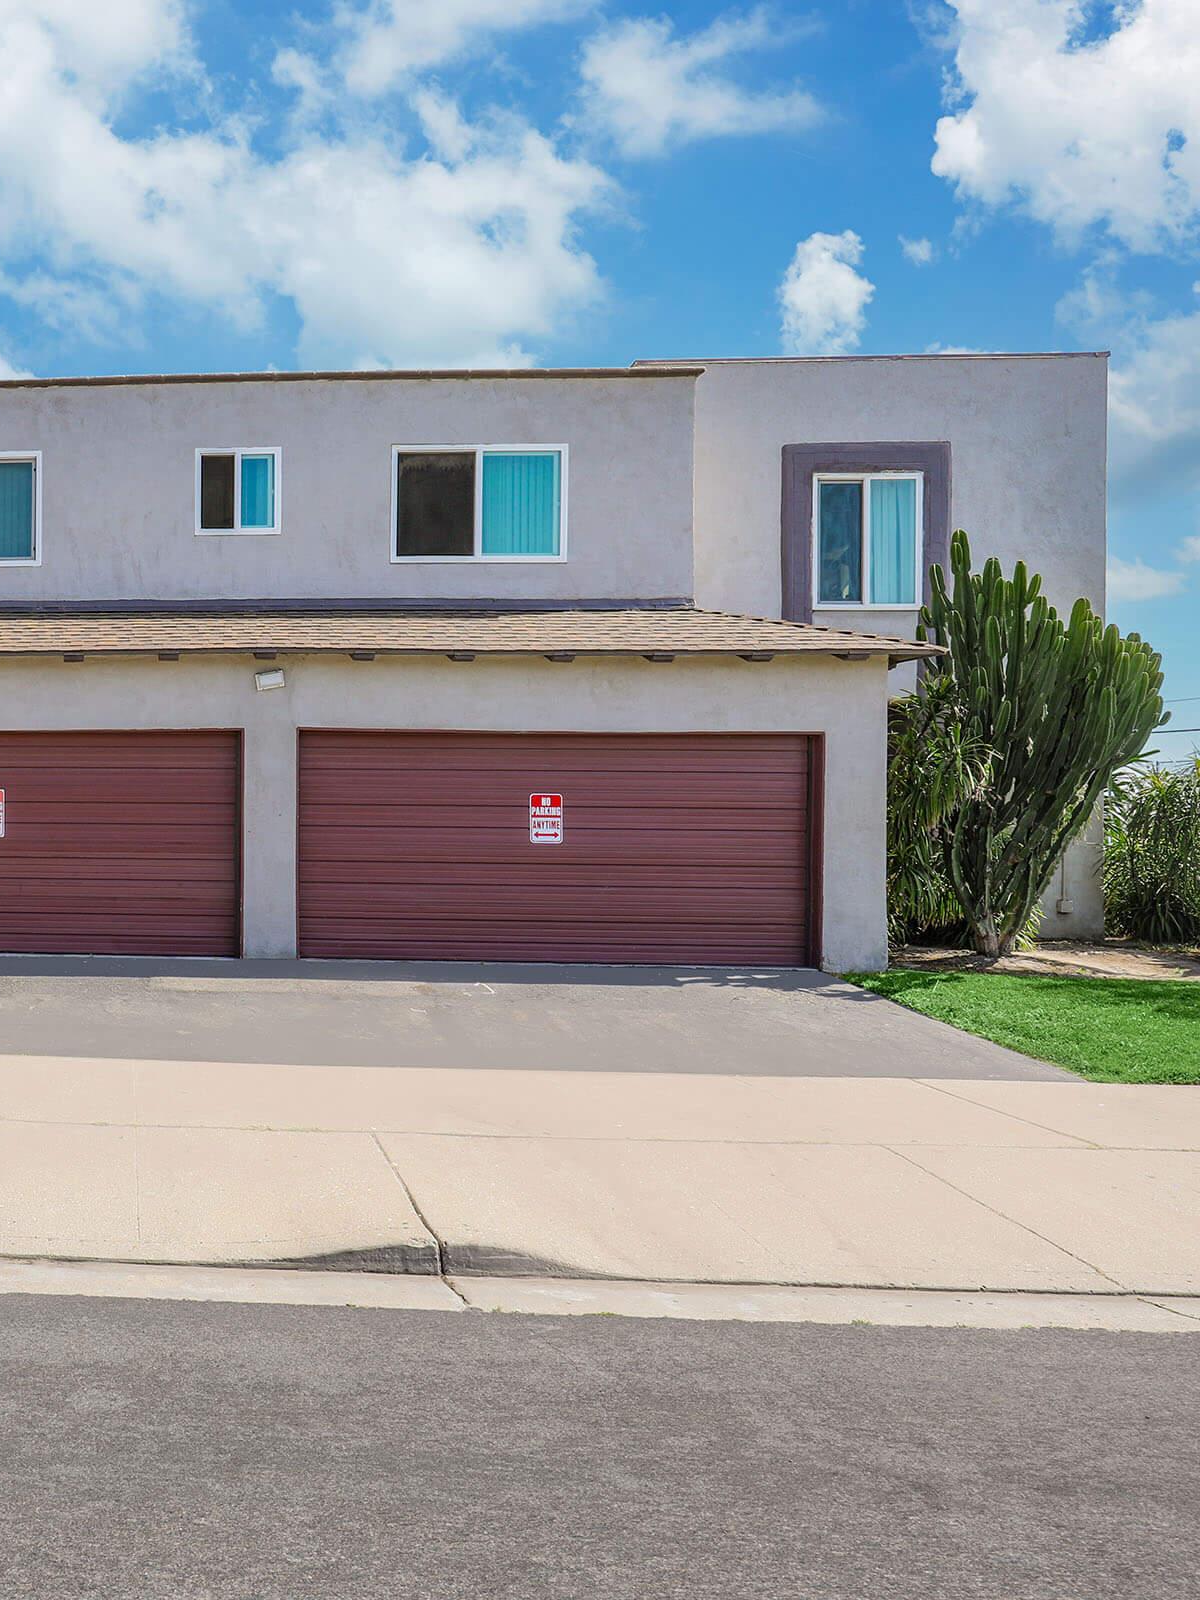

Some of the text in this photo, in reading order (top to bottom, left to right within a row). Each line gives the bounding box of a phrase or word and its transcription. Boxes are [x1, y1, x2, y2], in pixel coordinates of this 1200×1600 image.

[541, 797, 551, 806] NO
[531, 806, 561, 815] PARKING
[532, 820, 561, 829] ANYTIME
